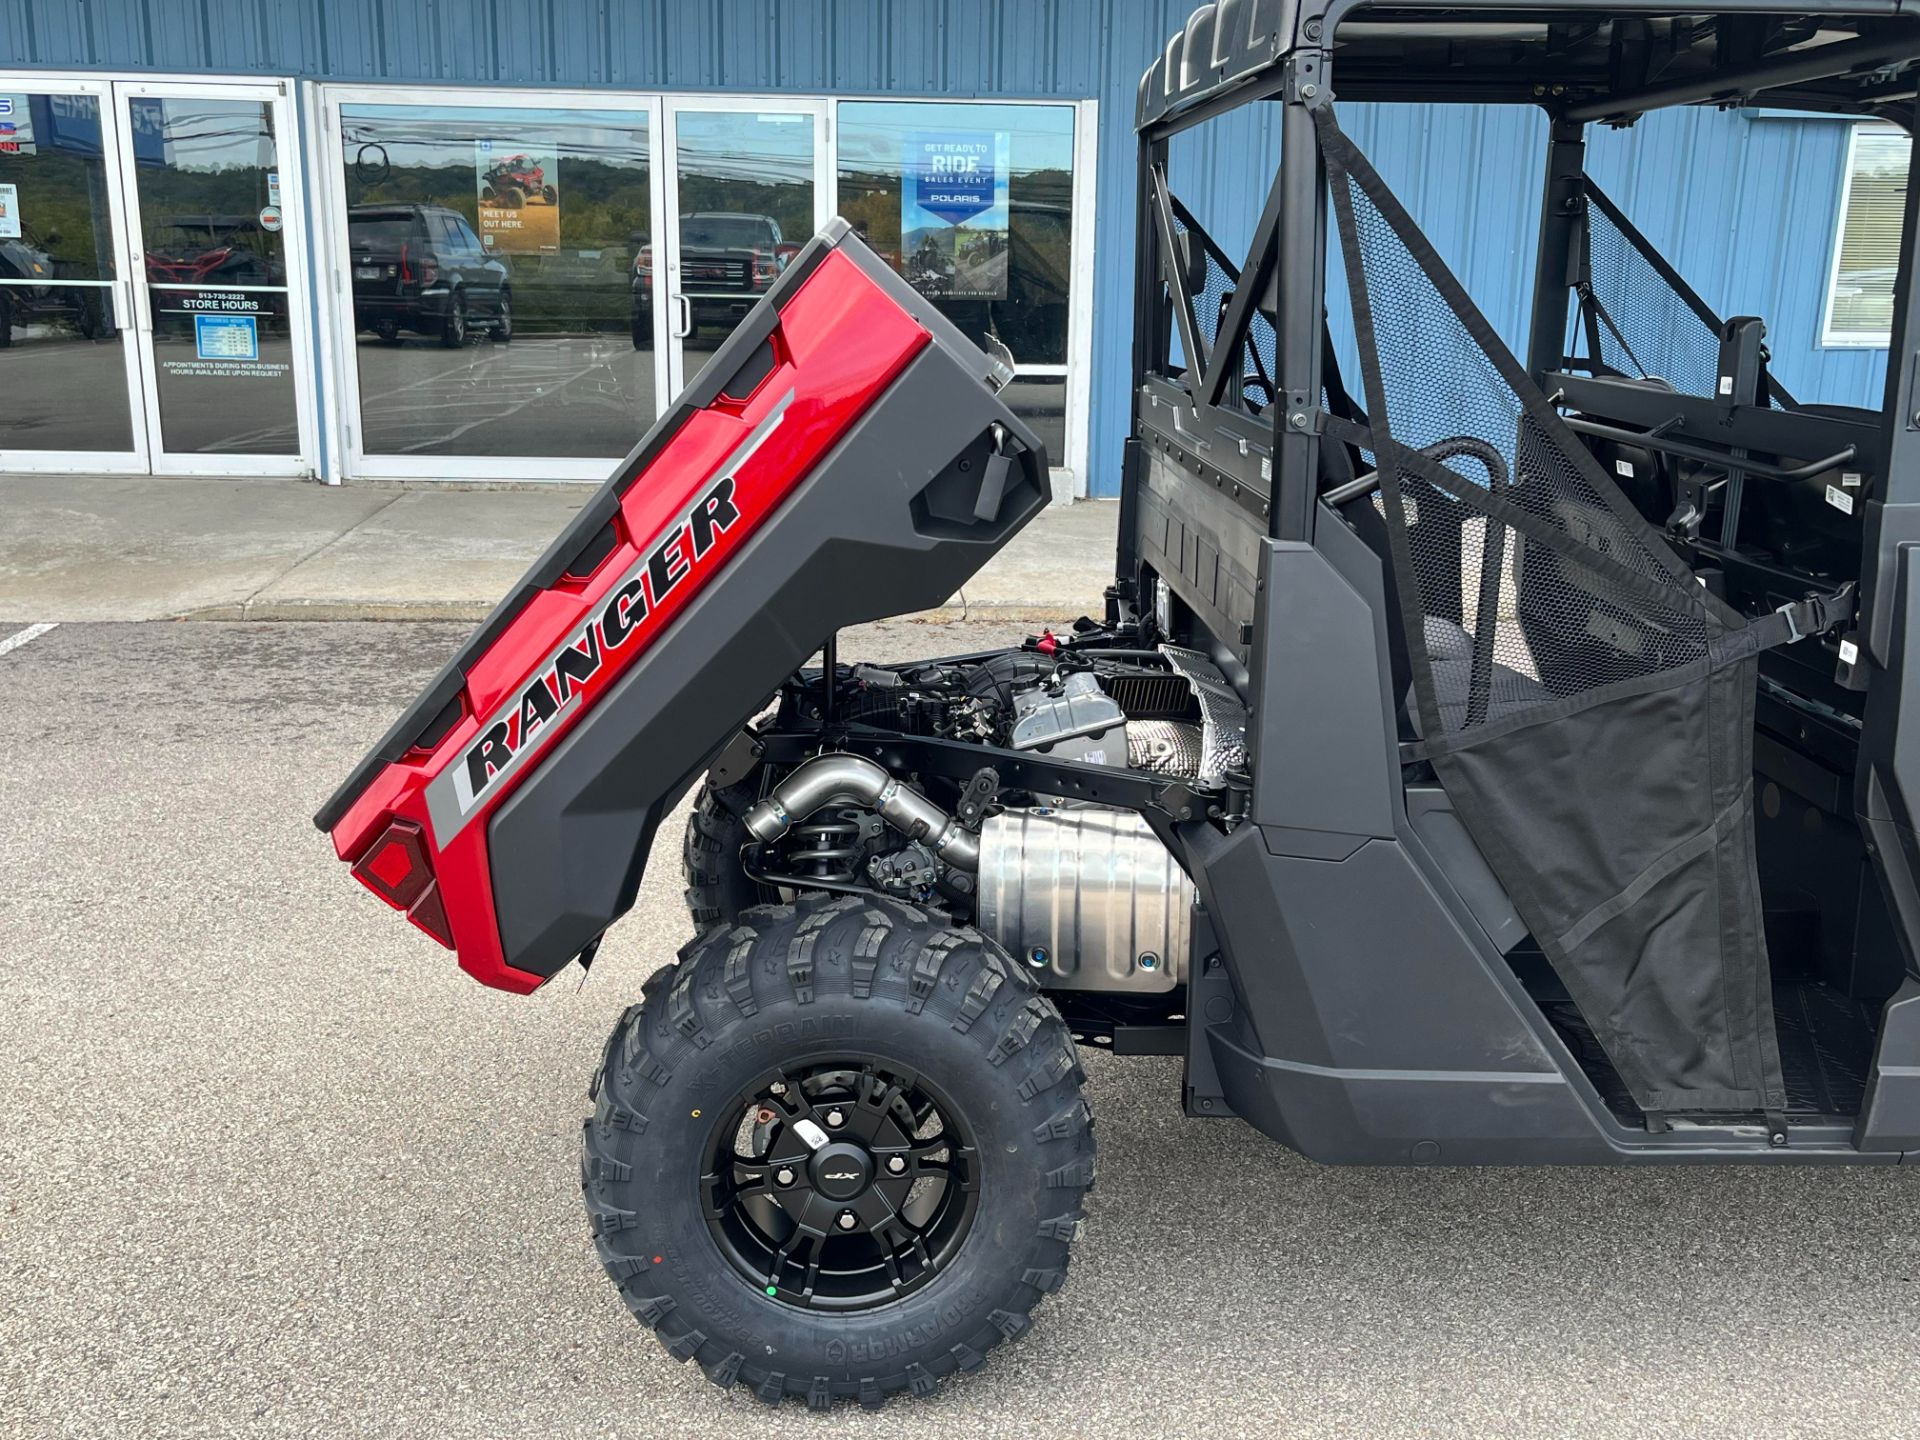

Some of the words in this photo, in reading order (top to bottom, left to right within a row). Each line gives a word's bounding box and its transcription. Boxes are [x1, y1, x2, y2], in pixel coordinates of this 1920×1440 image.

[924, 143, 942, 152] GET
[943, 143, 974, 153] READY
[975, 143, 988, 153] TO
[932, 155, 980, 173] RIDE
[957, 176, 987, 184] EVENT
[930, 194, 980, 203] POLARIS
[483, 210, 505, 218] MEET
[506, 210, 518, 218] US
[483, 220, 499, 228] OUT
[501, 220, 525, 229] HERE.
[182, 299, 220, 310] STORE
[221, 300, 259, 311] HOURS
[162, 361, 214, 369] APPOINTMENTS
[214, 362, 240, 370] DURING
[241, 363, 290, 371] NON-BUSINESS
[195, 369, 231, 377] AVAILABLE
[464, 477, 742, 799] RANGER
[824, 1172, 860, 1180] XP
